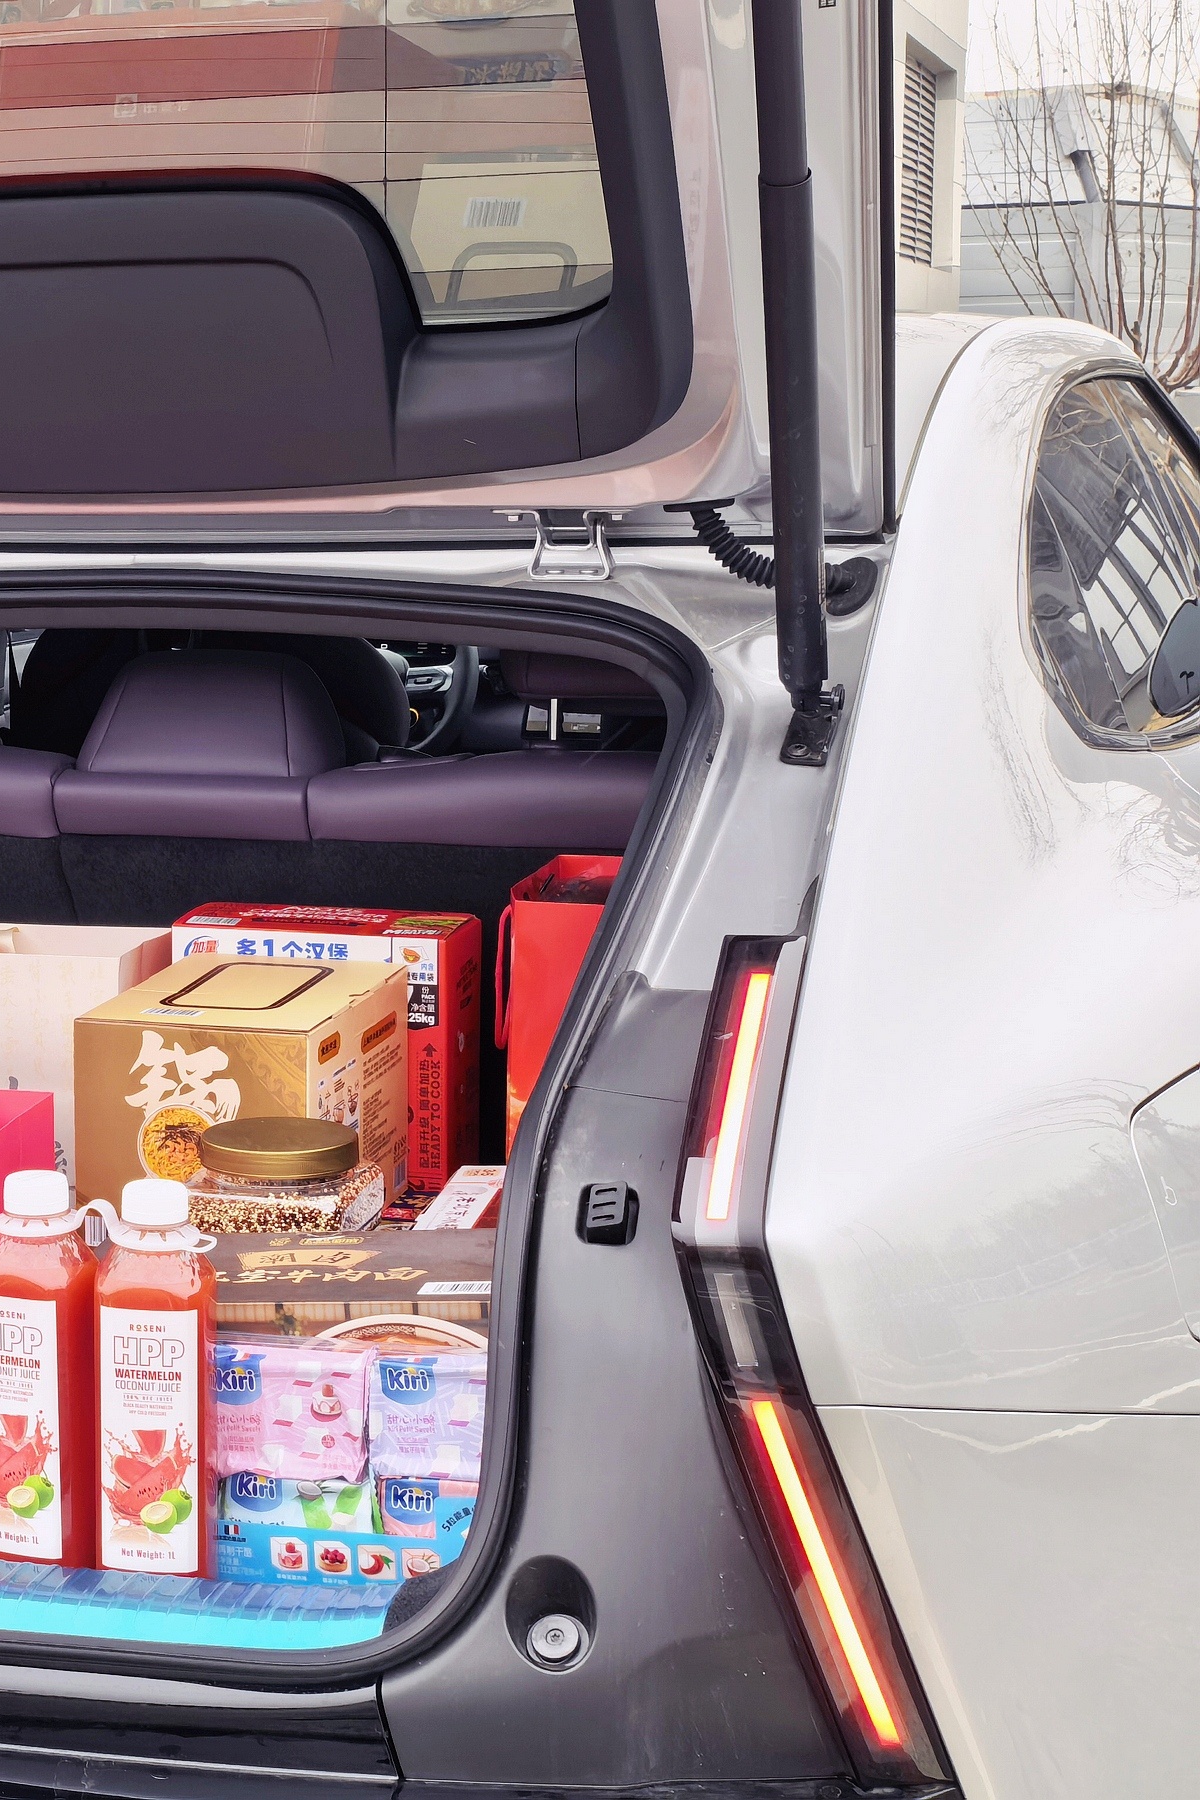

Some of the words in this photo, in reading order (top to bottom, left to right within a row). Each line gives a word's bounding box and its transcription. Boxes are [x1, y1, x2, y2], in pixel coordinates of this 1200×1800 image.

[191, 940, 217, 953] 加量
[236, 938, 349, 960] 多1个汉堡
[407, 972, 435, 982] 专用袋
[410, 1003, 435, 1013] 净含量
[431, 1060, 440, 1098] COOK
[431, 1103, 440, 1121] TO
[431, 1124, 440, 1169] READY
[113, 1335, 184, 1367] HPP
[19, 1368, 40, 1381] JUICE
[114, 1368, 182, 1382] WATERMELON
[216, 1368, 256, 1392] Kiri
[386, 1367, 430, 1391] Kiri
[115, 1379, 155, 1392] COCONUT
[157, 1381, 181, 1392] JUICE
[237, 1472, 277, 1500] Kiri
[392, 1485, 433, 1513] Kiri
[441, 1504, 476, 1532] 5粒能量
[4, 1530, 30, 1544] Weight:
[31, 1536, 39, 1545] 1L
[121, 1548, 134, 1558] Net
[136, 1549, 165, 1561] Weight:
[167, 1551, 176, 1560] 1L
